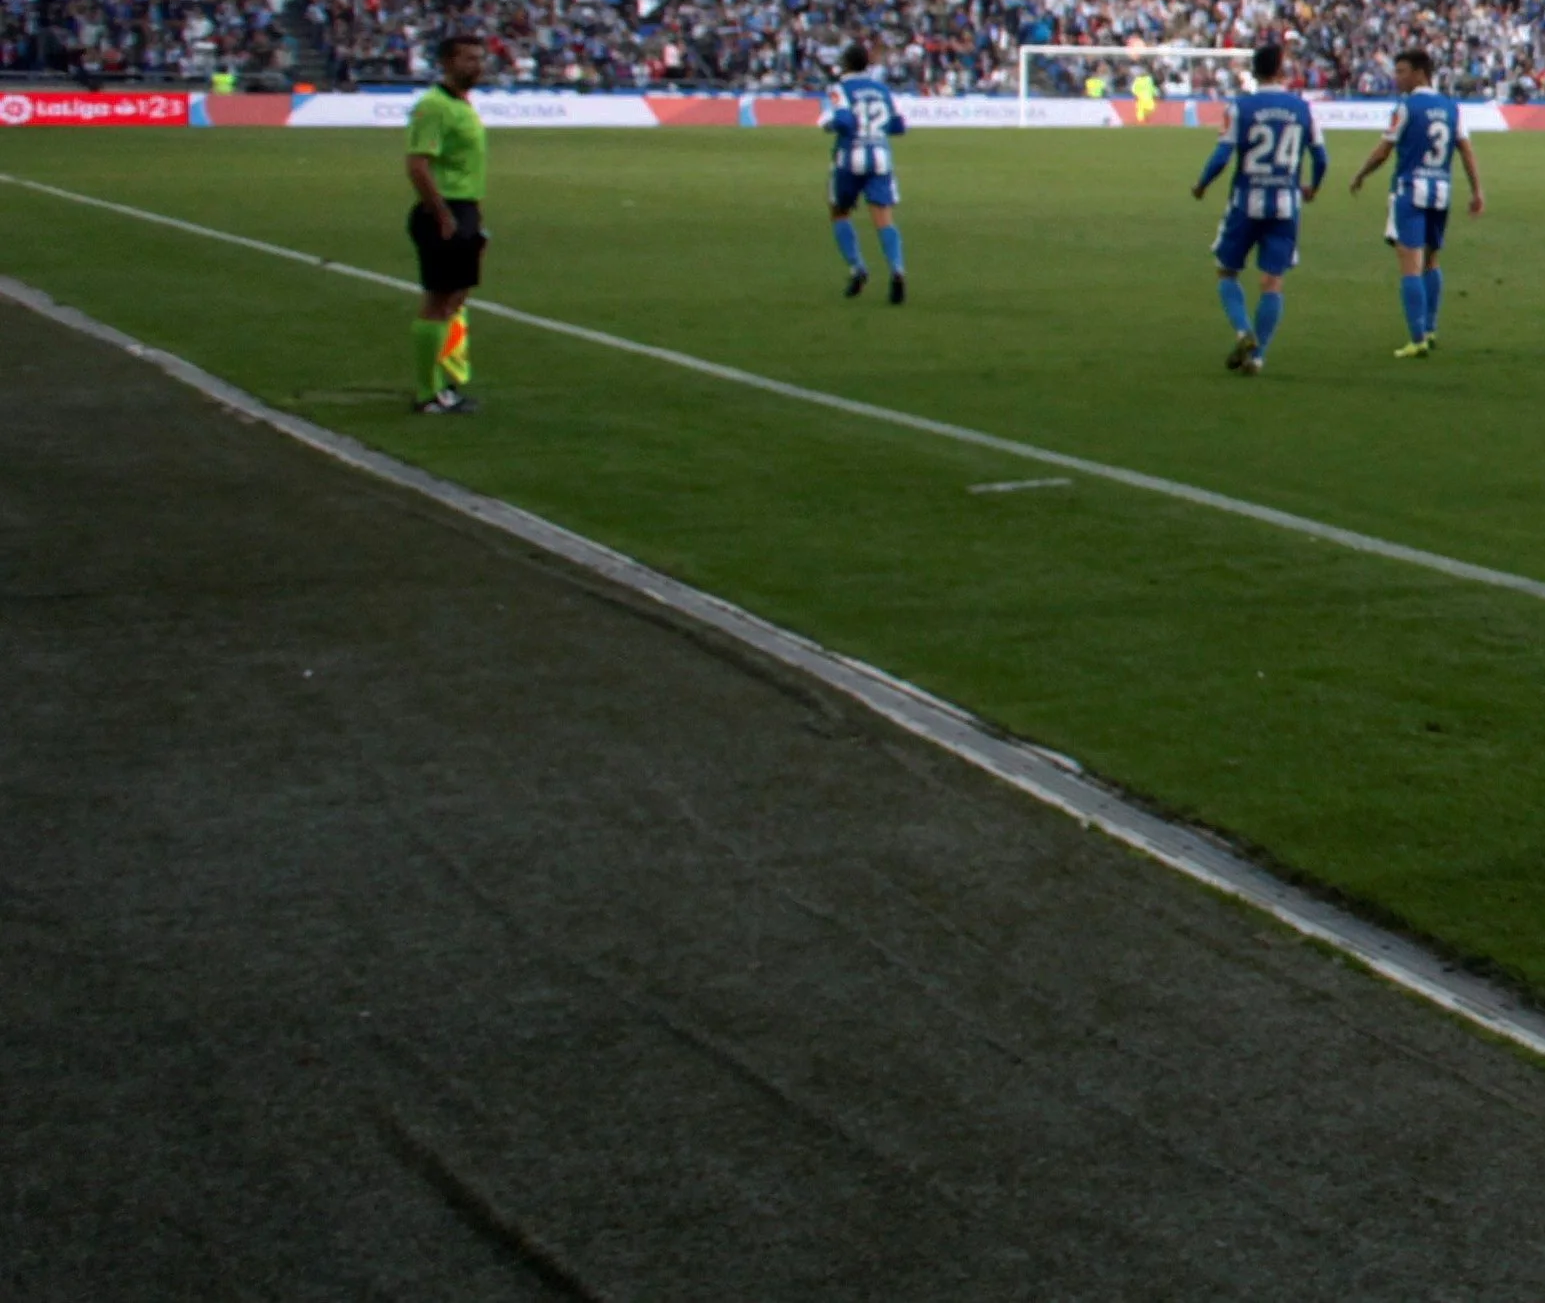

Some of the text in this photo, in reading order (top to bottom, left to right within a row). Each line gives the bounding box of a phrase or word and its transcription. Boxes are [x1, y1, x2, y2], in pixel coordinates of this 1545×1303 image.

[37, 98, 110, 120] LaLiga
[853, 101, 888, 137] 12
[1243, 123, 1302, 174] 24
[1423, 121, 1450, 167] 3
